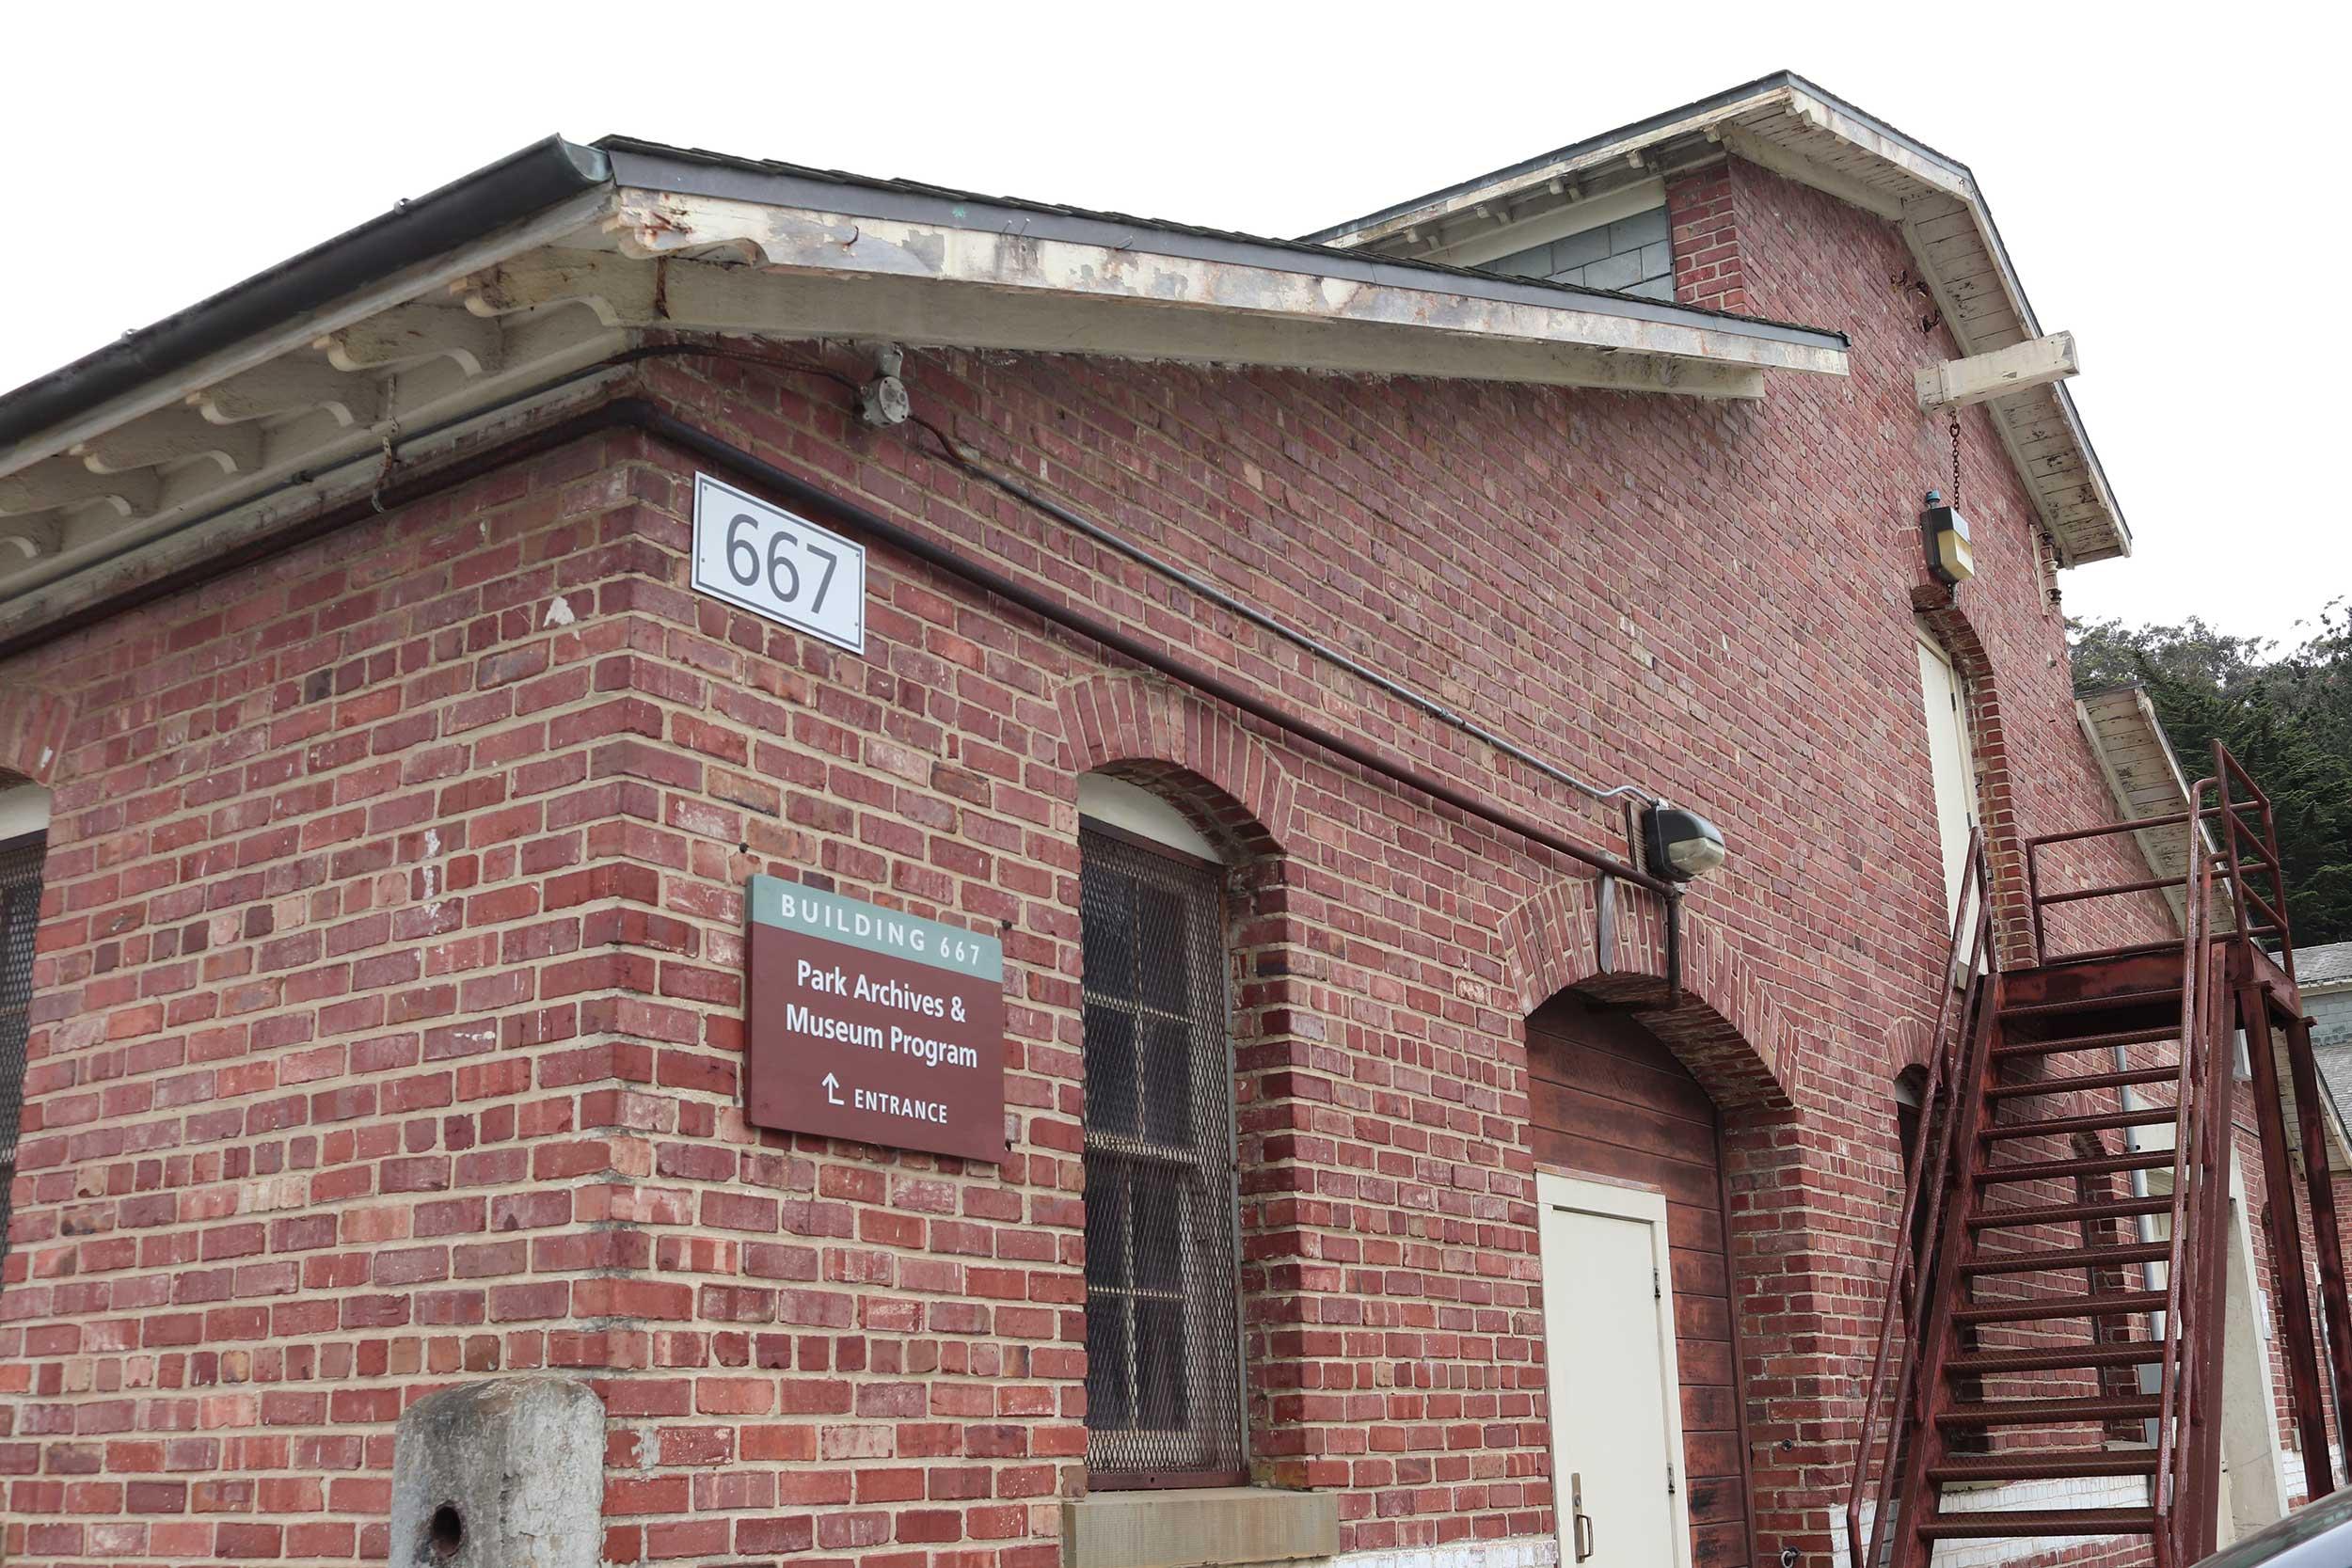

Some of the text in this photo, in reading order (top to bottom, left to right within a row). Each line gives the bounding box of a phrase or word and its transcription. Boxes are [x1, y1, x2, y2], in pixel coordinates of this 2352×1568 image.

[725, 513, 837, 614] 667
[781, 894, 979, 966] BUILDING 667
[797, 959, 966, 1022] Park Archives &
[786, 1003, 977, 1068] Museum Program
[854, 1088, 947, 1124] ENTRANCE
